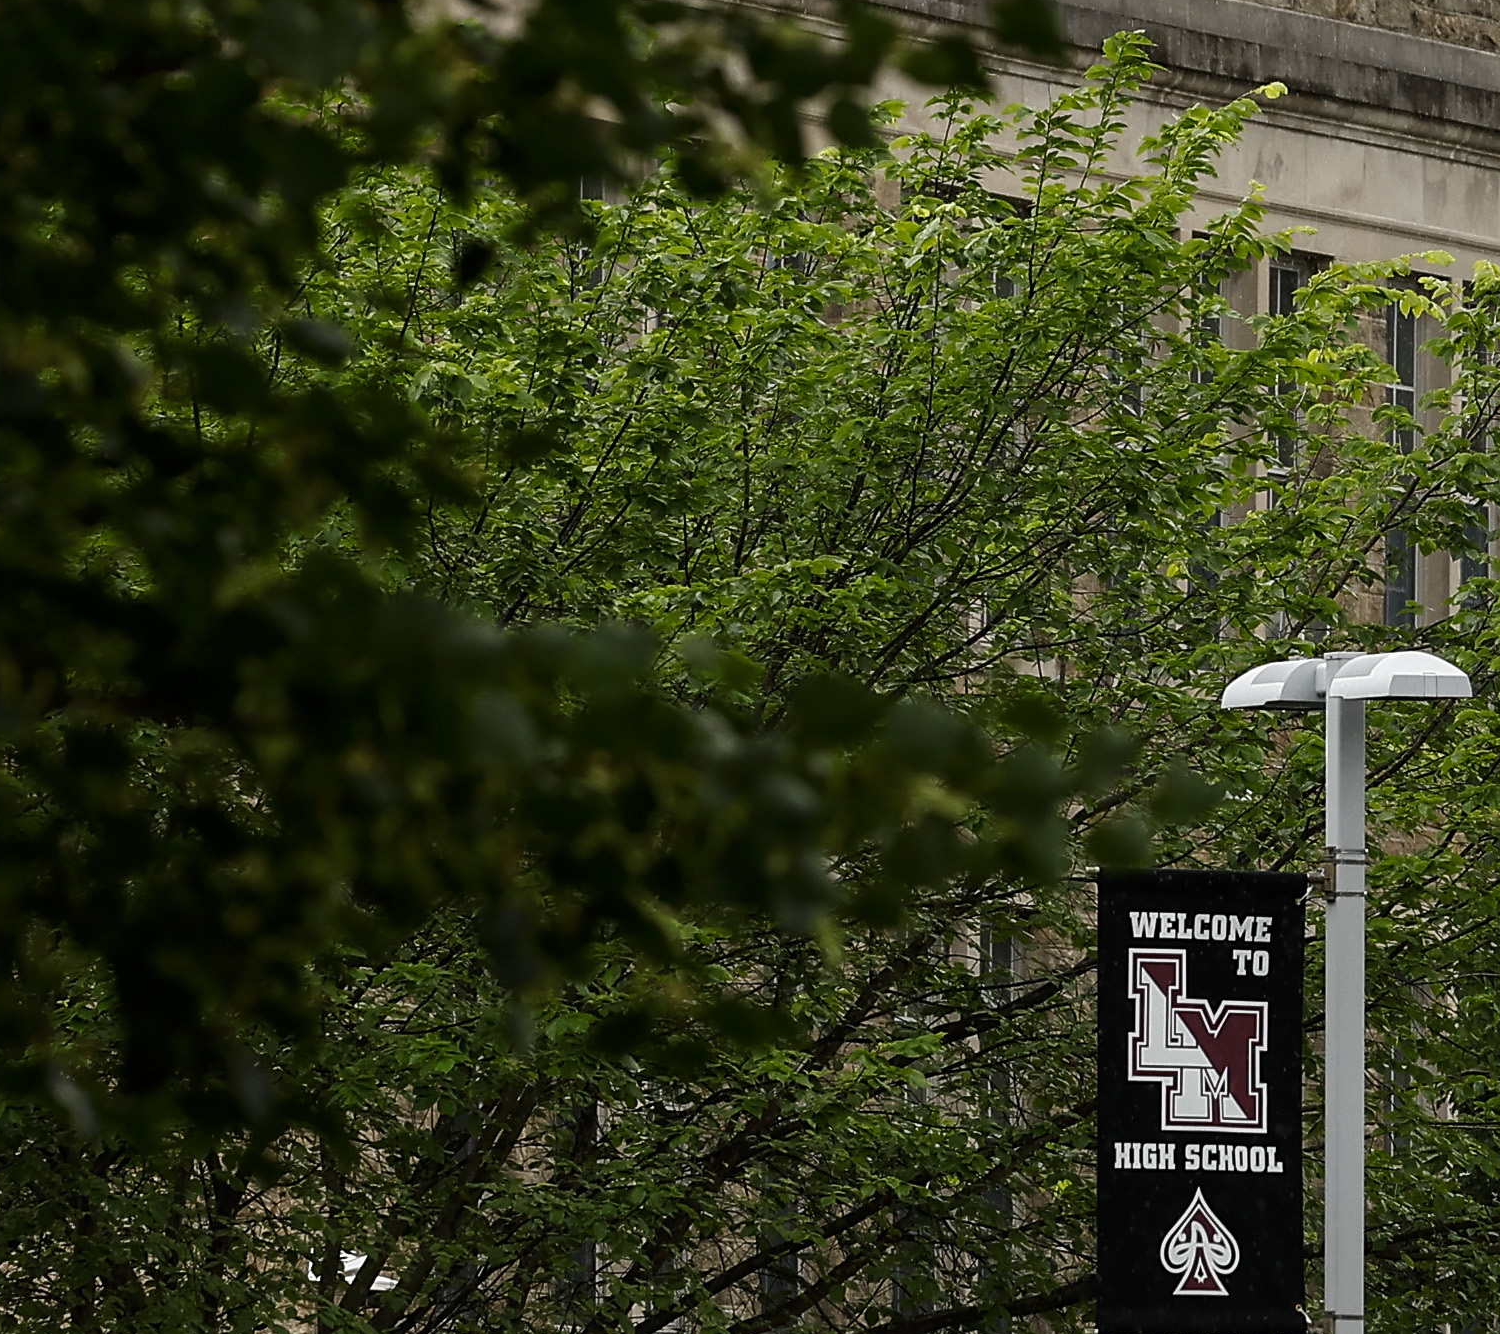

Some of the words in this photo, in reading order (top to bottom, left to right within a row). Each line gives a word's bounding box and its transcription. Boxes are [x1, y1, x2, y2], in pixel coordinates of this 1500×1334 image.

[1129, 911, 1274, 943] WELCOME
[1232, 948, 1270, 977] TO
[1113, 1141, 1177, 1171] HIGH
[1184, 1144, 1284, 1173] SCHOOL
